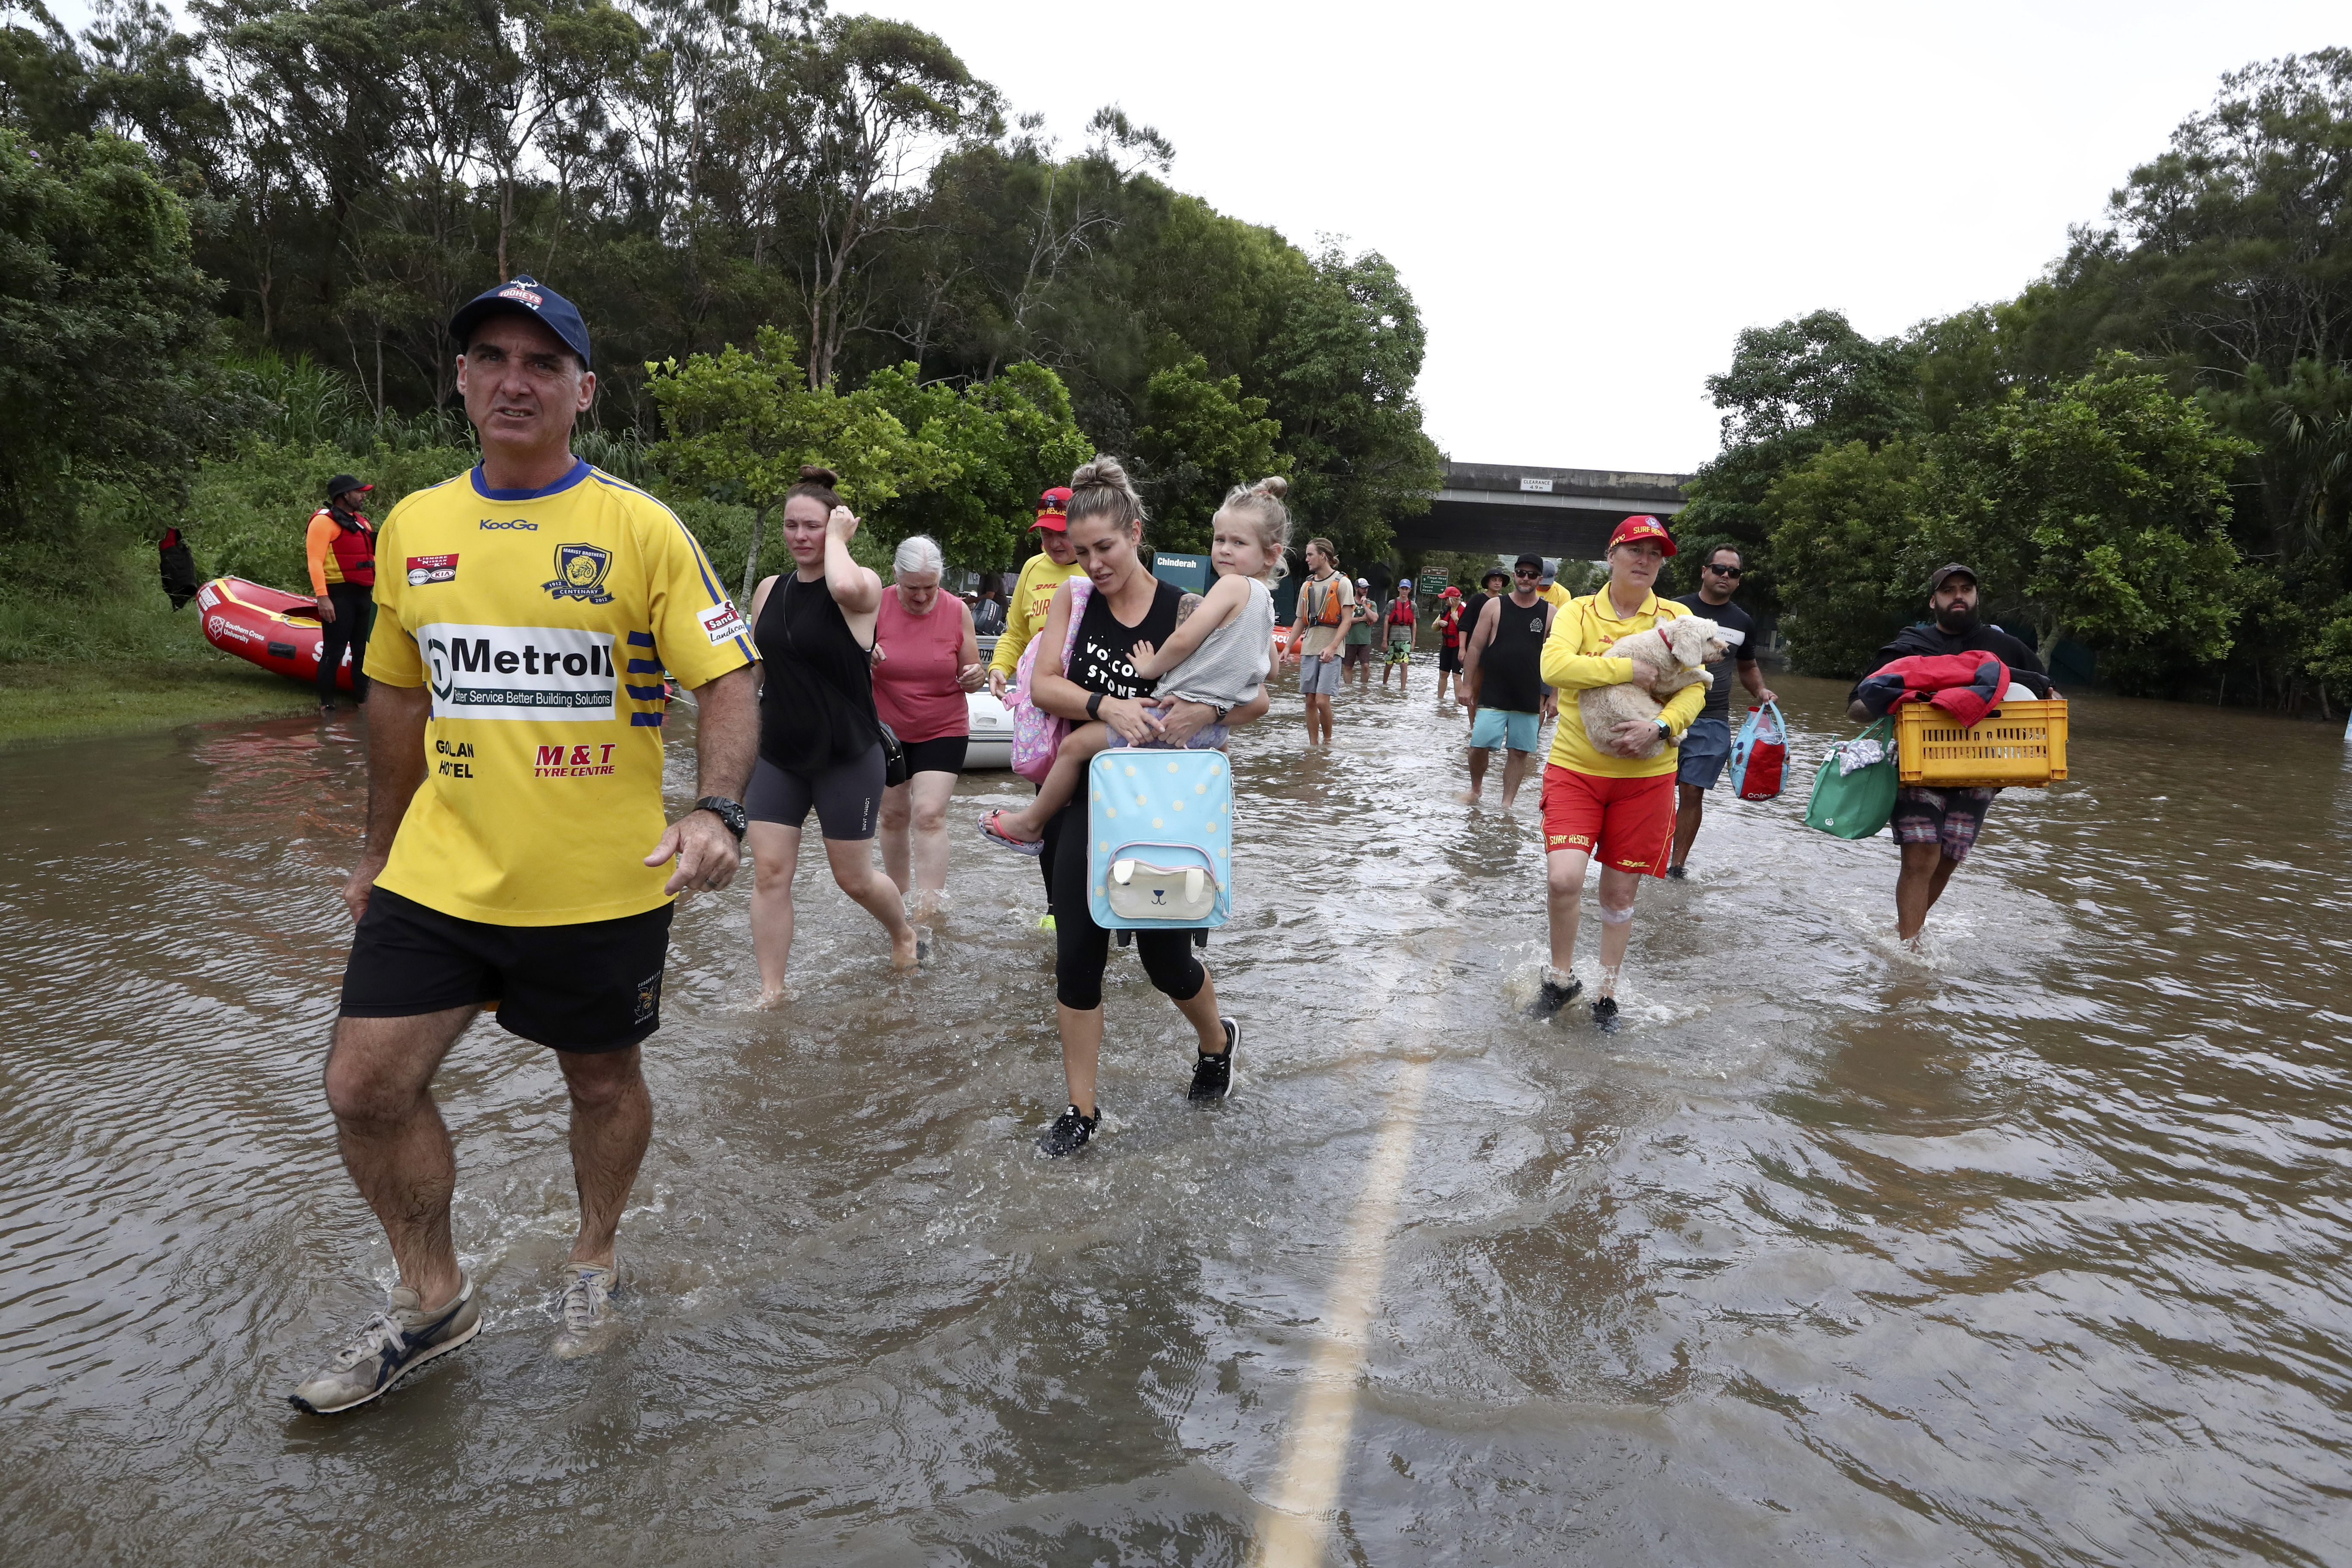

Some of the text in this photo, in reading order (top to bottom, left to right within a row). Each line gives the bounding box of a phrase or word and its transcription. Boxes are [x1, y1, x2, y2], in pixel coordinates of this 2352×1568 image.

[500, 290, 540, 303] TOOHEYS
[480, 519, 538, 531] KooGa
[1651, 527, 1665, 537] RES
[1157, 557, 1197, 568] Chinderah
[1030, 599, 1050, 617] SUR
[709, 612, 734, 628] Sand
[224, 628, 249, 644] University
[225, 622, 265, 641] Southern Cross
[451, 638, 614, 677] Metroll
[1087, 642, 1142, 678] VOCO
[1087, 665, 1137, 699] STONE
[470, 690, 503, 702] Service
[506, 692, 533, 704] Better
[536, 692, 573, 707] Building
[575, 693, 610, 704] Solutions
[436, 740, 474, 758] GOLAN
[534, 743, 616, 766] M & T
[438, 760, 473, 778] HOTEL
[534, 765, 616, 778] TYRE CENTRE
[1550, 834, 1590, 847] SURF RESCUE
